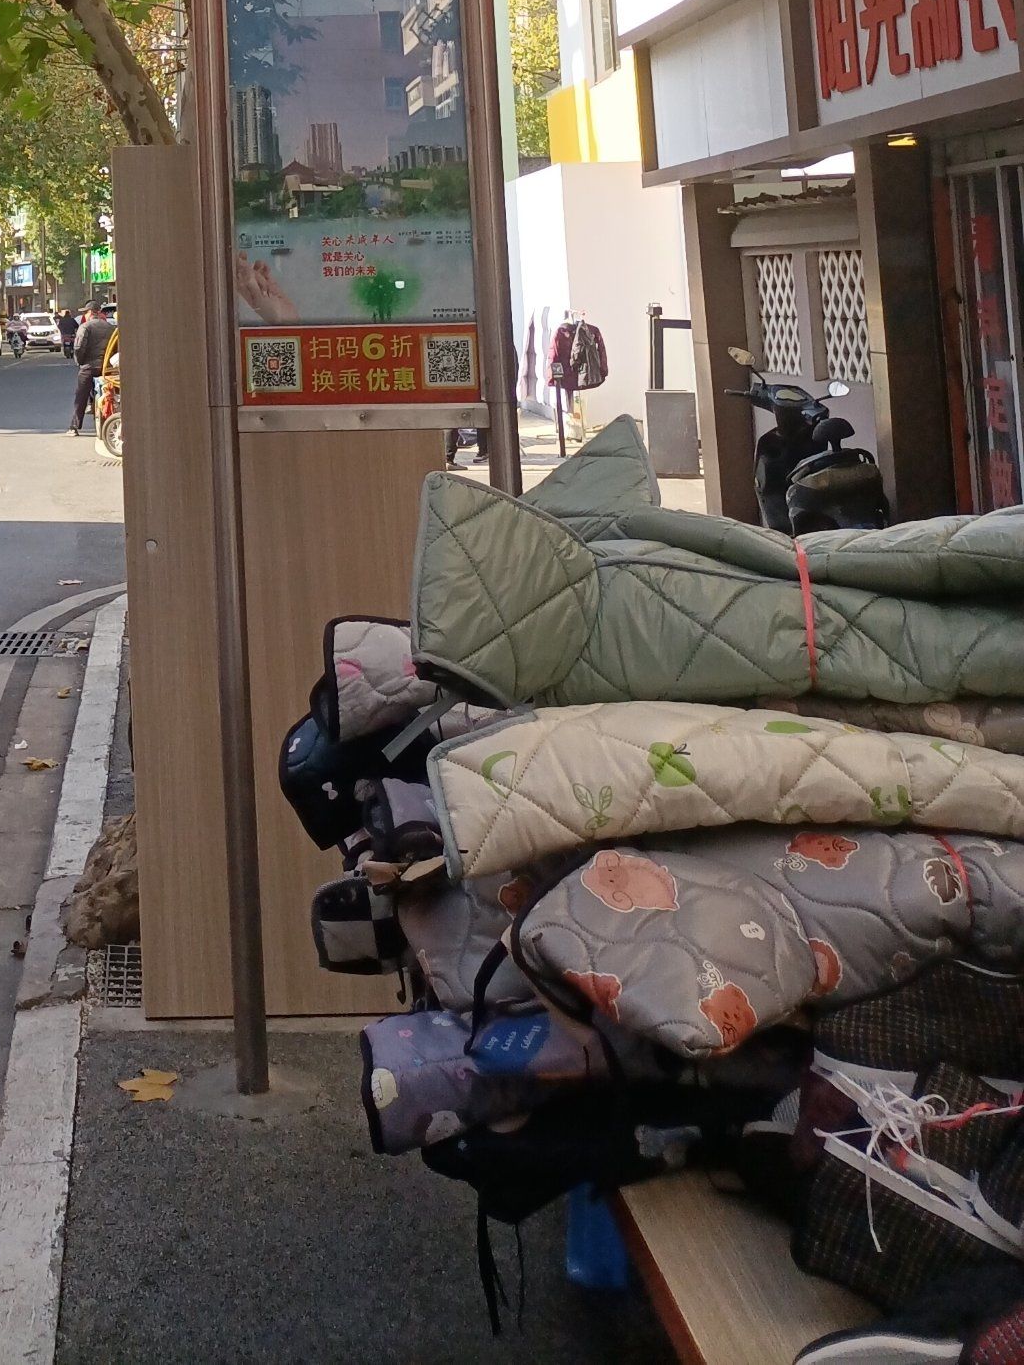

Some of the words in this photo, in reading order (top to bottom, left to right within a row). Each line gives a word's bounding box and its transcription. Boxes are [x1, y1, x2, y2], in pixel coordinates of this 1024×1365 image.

[321, 251, 365, 262] 就是关心
[323, 265, 377, 277] 我们的未来
[309, 333, 413, 360] 扫码6折
[312, 367, 416, 392] 换乘优惠
